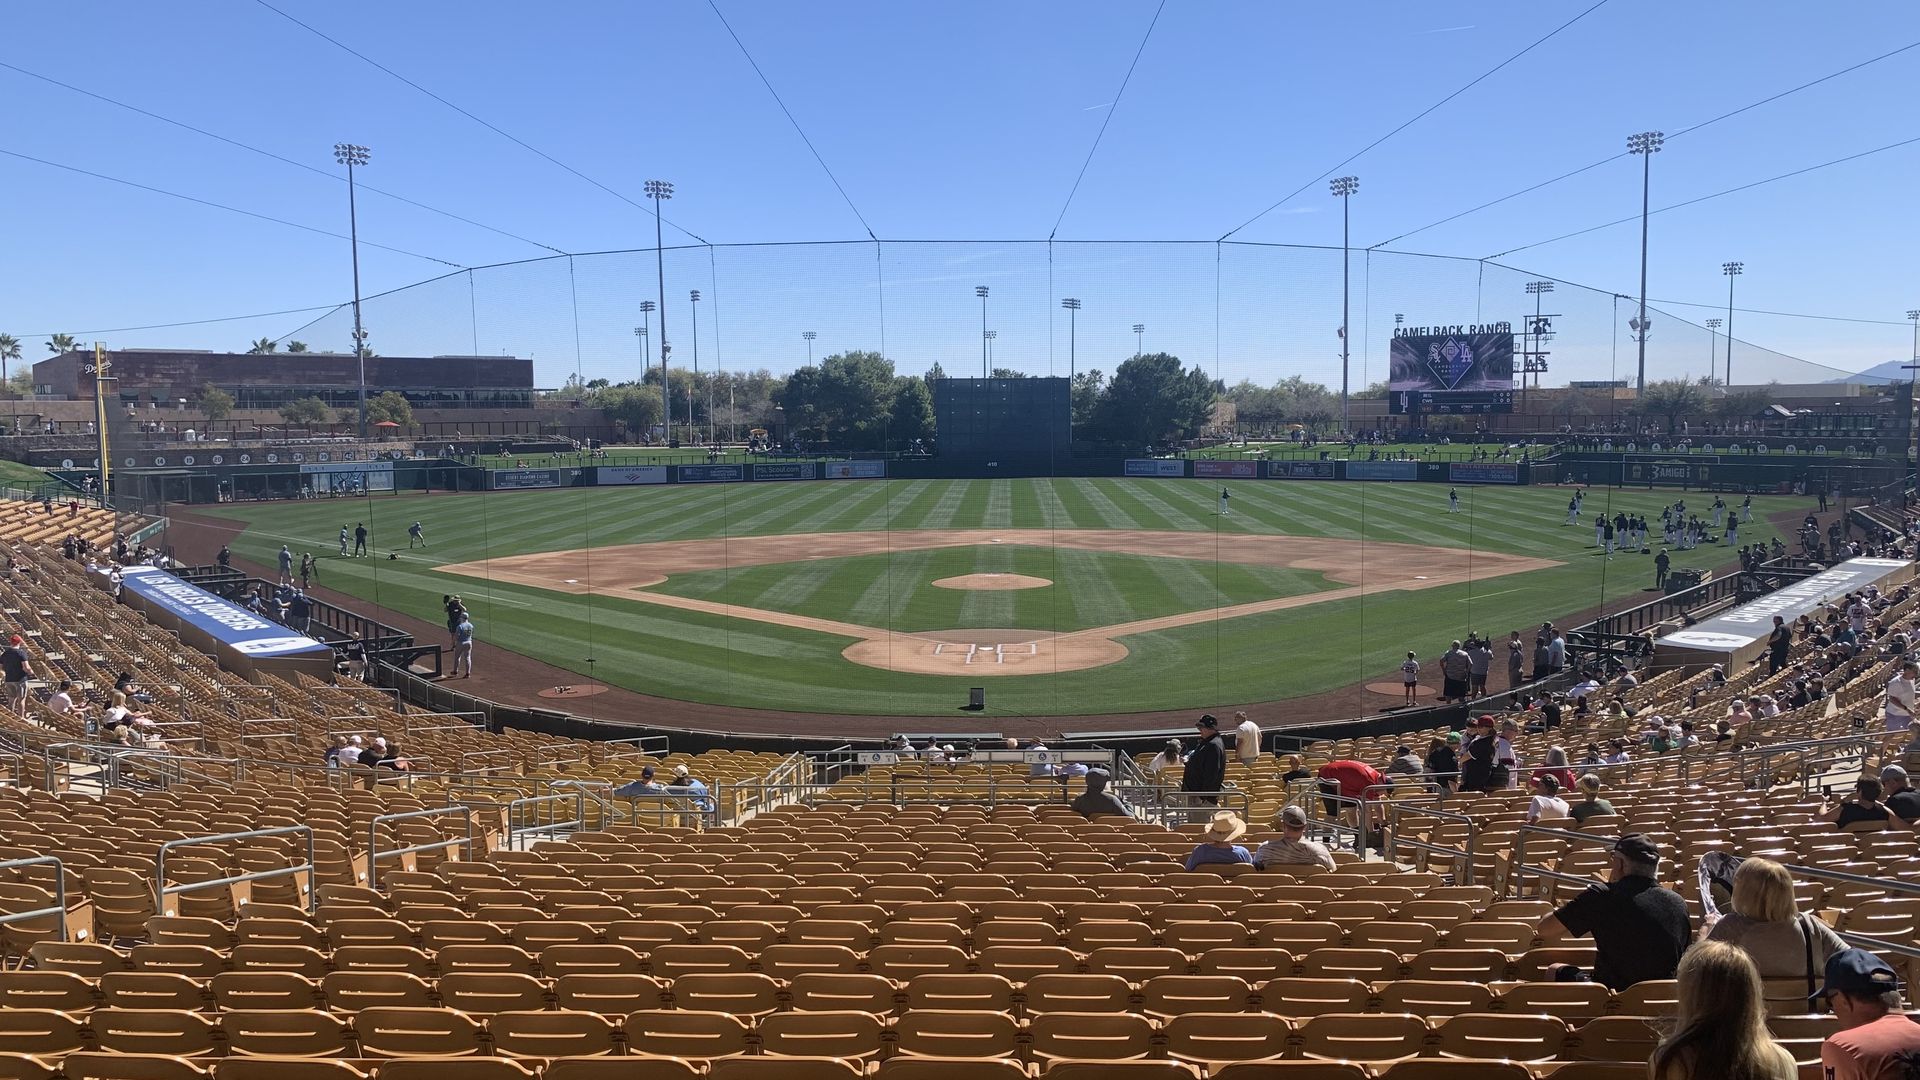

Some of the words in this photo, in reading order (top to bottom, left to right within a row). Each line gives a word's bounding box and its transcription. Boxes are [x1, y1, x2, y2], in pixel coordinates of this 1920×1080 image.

[1394, 325, 1463, 338] CAMELBACK
[1470, 322, 1511, 335] RANCH
[136, 575, 175, 585] LOS
[152, 584, 217, 604] ANGELES
[192, 603, 270, 630] DODGERS
[1719, 595, 1805, 623] CHICAGO
